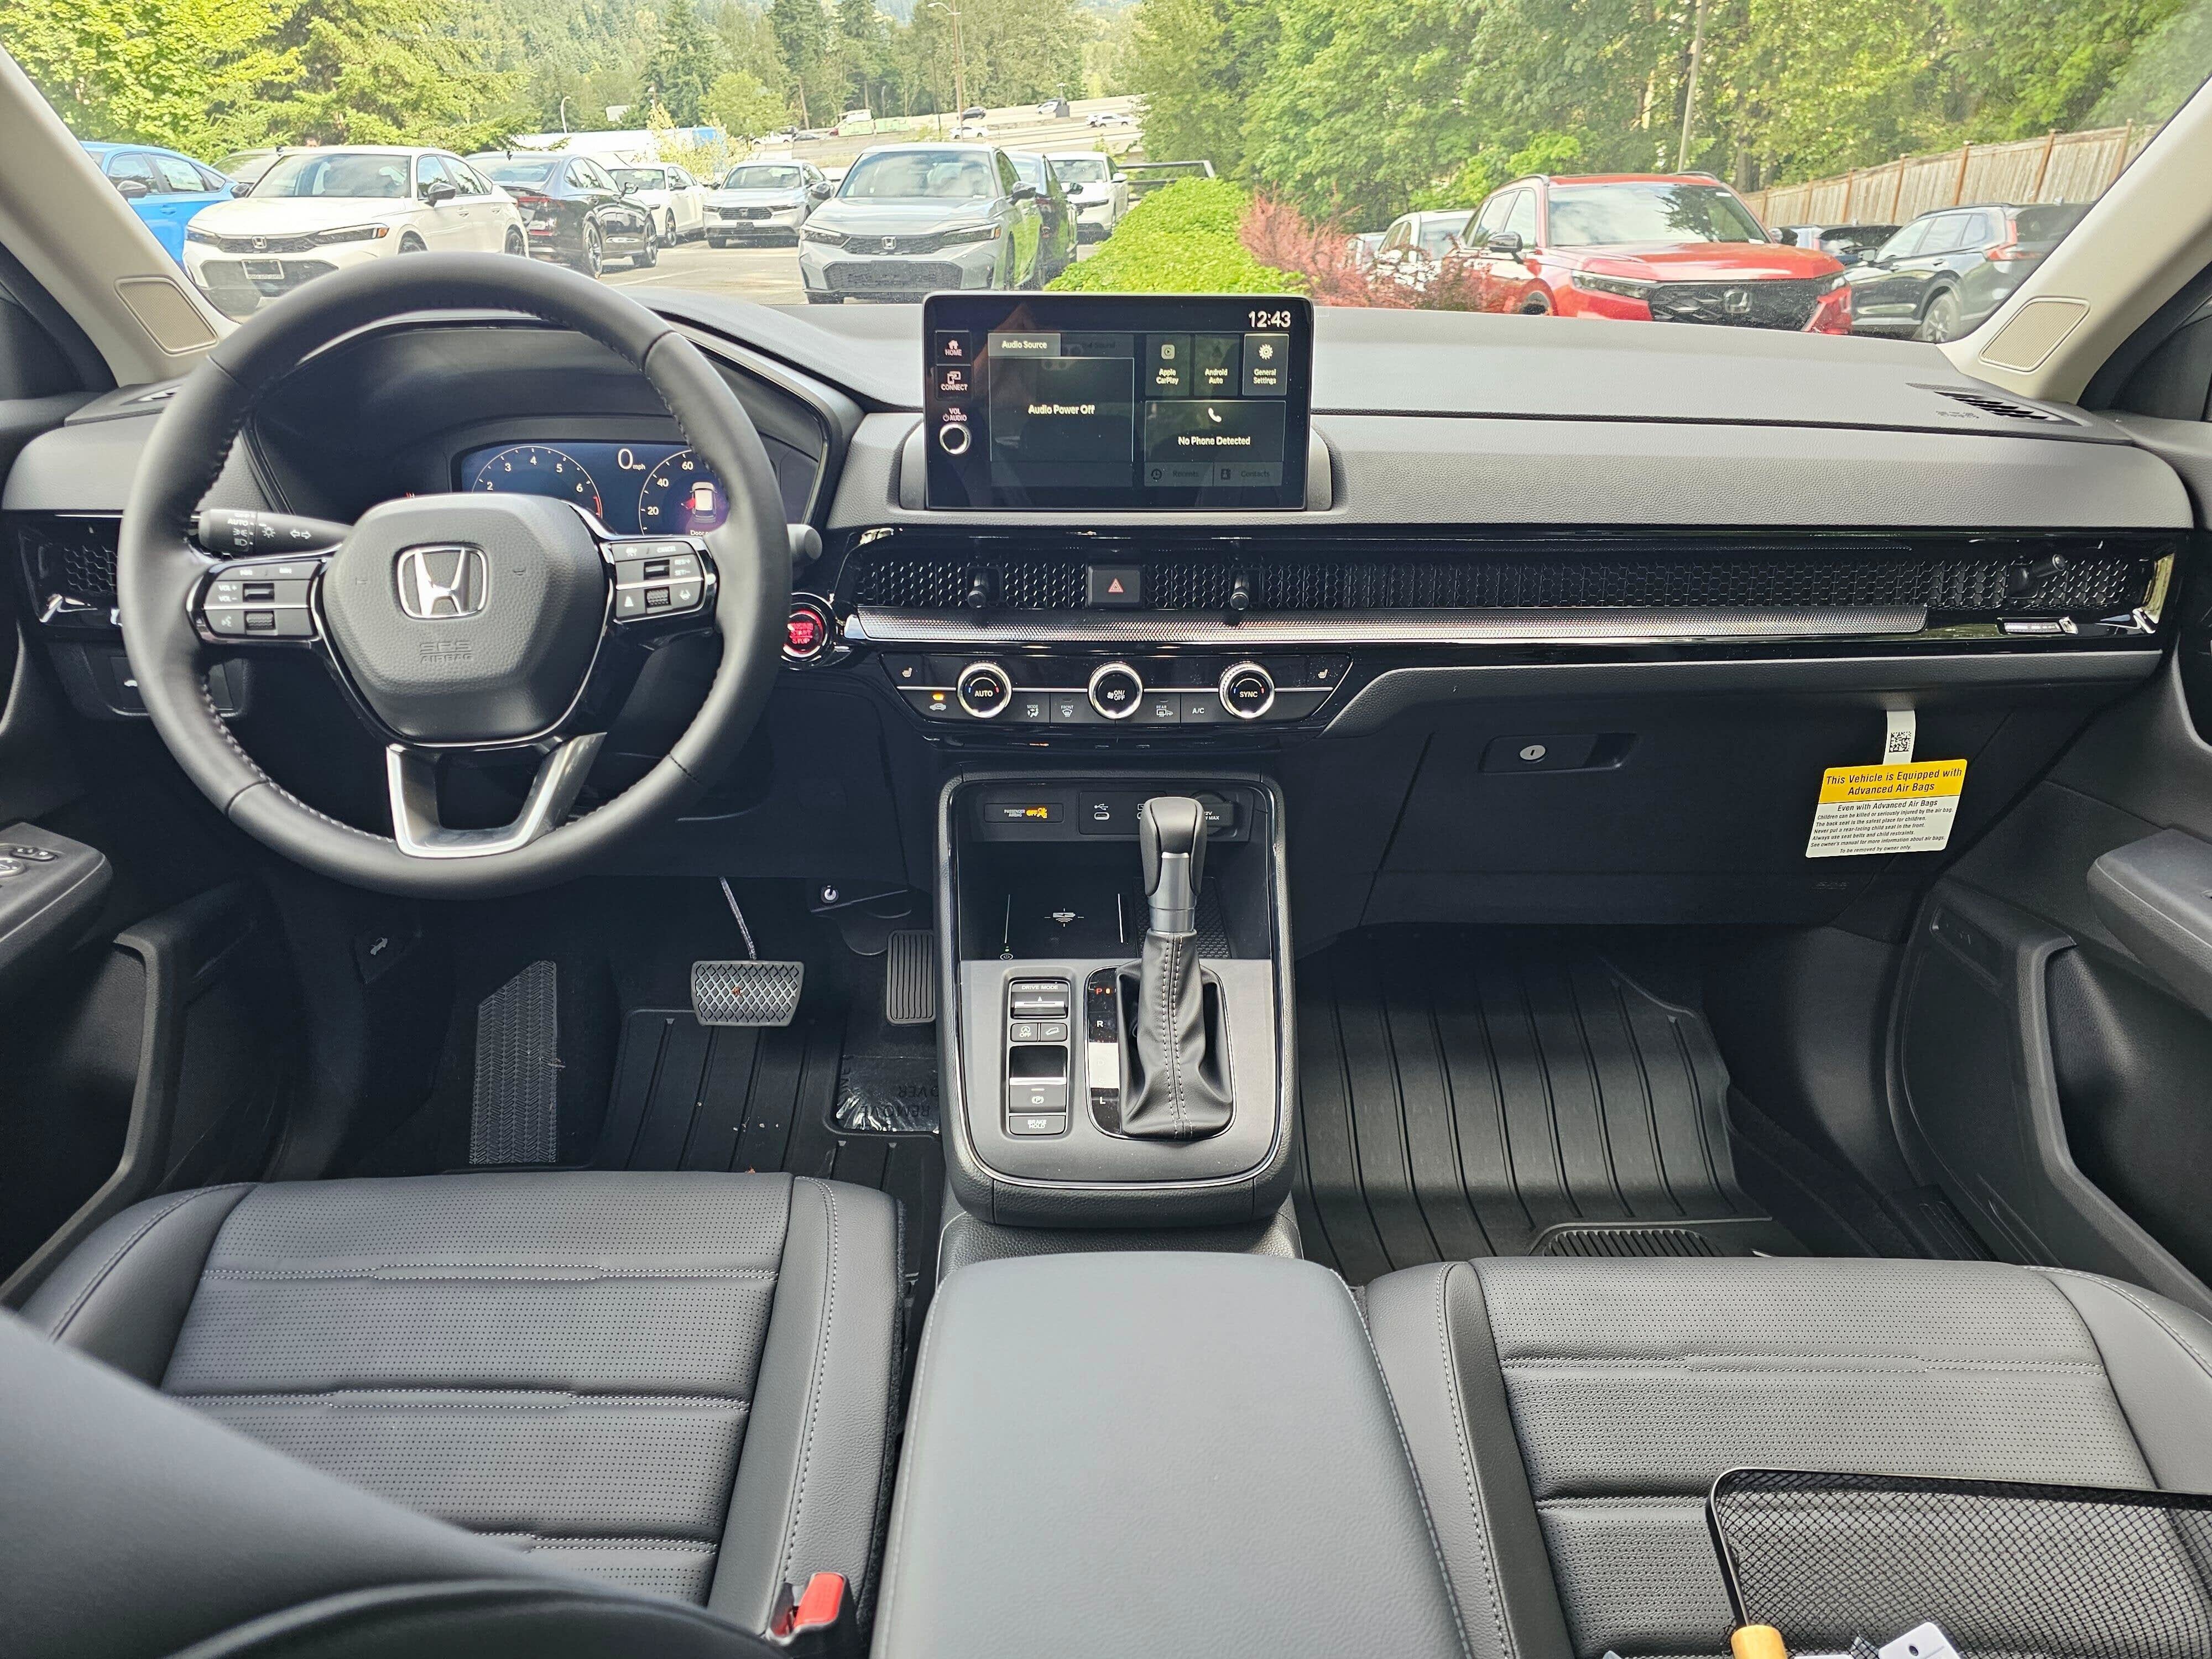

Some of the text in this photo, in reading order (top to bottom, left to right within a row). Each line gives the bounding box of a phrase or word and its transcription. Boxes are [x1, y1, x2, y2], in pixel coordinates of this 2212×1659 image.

[1248, 310, 1291, 327] 12:43
[1023, 341, 1047, 349] Source
[1159, 368, 1176, 377] Apple
[1156, 376, 1178, 385] CarPlay
[1253, 377, 1276, 385] Settings
[1028, 404, 1095, 415] Audio Power Off
[1178, 436, 1251, 445] No Phone Detected
[530, 456, 537, 466] 4
[618, 448, 633, 469] 0
[504, 463, 512, 472] 3
[556, 463, 563, 473] 5
[681, 461, 693, 470] 60
[487, 481, 493, 491] 2
[656, 478, 669, 487] 40
[576, 483, 583, 493] 6
[647, 506, 659, 515] 20
[1827, 768, 1962, 785] This Vehicle is Equipped with
[1848, 783, 1935, 795] Advanced Air Bags
[1872, 801, 1907, 810] Advanced
[1099, 1096, 1106, 1104] L
